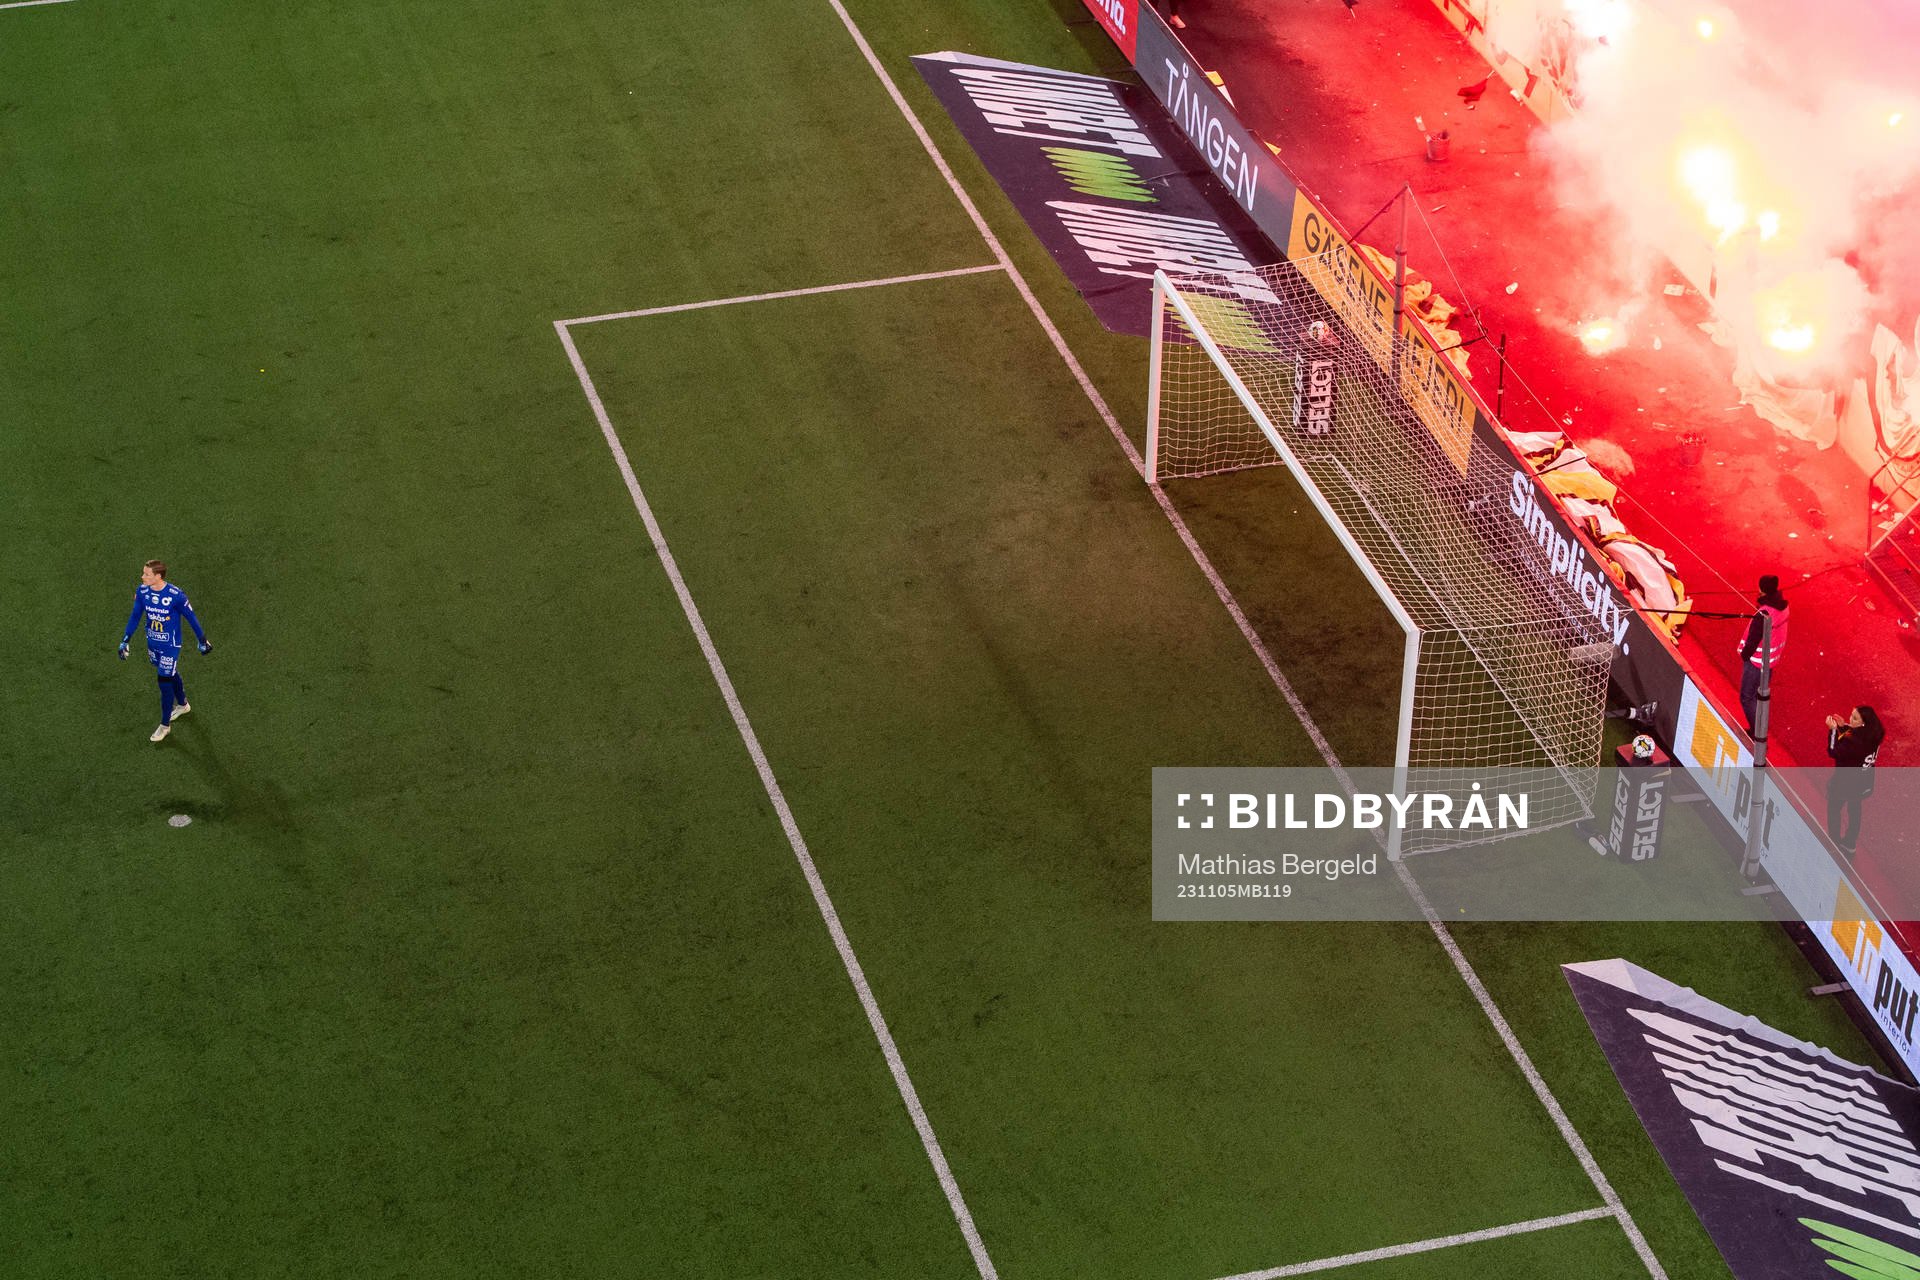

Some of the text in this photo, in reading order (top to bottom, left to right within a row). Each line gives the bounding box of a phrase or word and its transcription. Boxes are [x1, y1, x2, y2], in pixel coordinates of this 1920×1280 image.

[949, 69, 1162, 158] UNIBET
[1165, 57, 1258, 213] TÅNGEN
[1304, 212, 1387, 334] GÄSENE
[1307, 361, 1333, 434] SELECT
[1609, 769, 1631, 855] SELECT
[1632, 781, 1664, 861] SELECT
